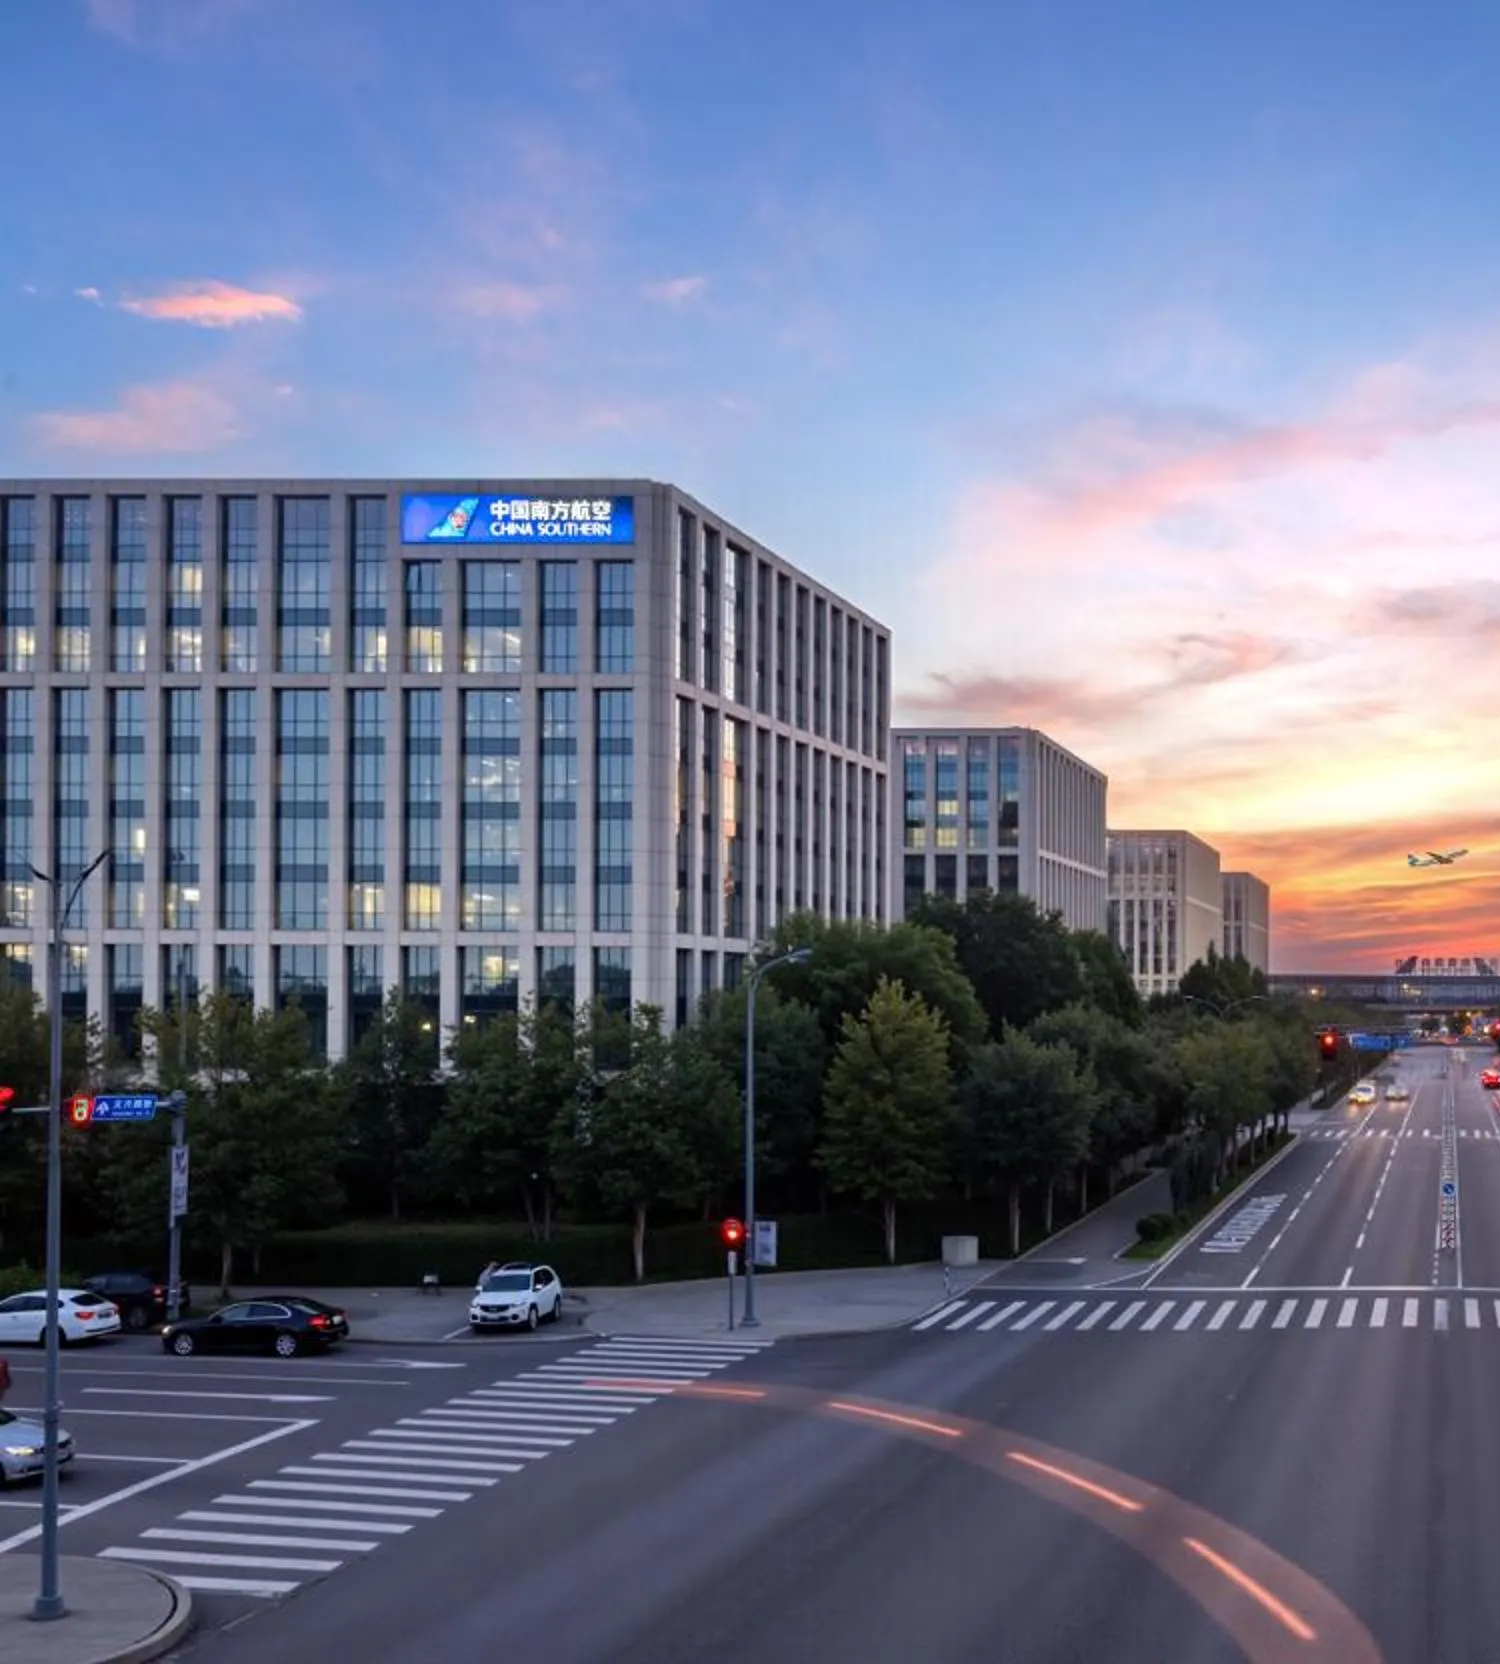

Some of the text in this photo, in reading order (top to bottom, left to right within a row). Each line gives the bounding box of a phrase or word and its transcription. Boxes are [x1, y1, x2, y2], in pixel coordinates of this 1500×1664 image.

[489, 499, 611, 520] 中国南方航空
[489, 522, 611, 536] CHINA SOUTHERN
